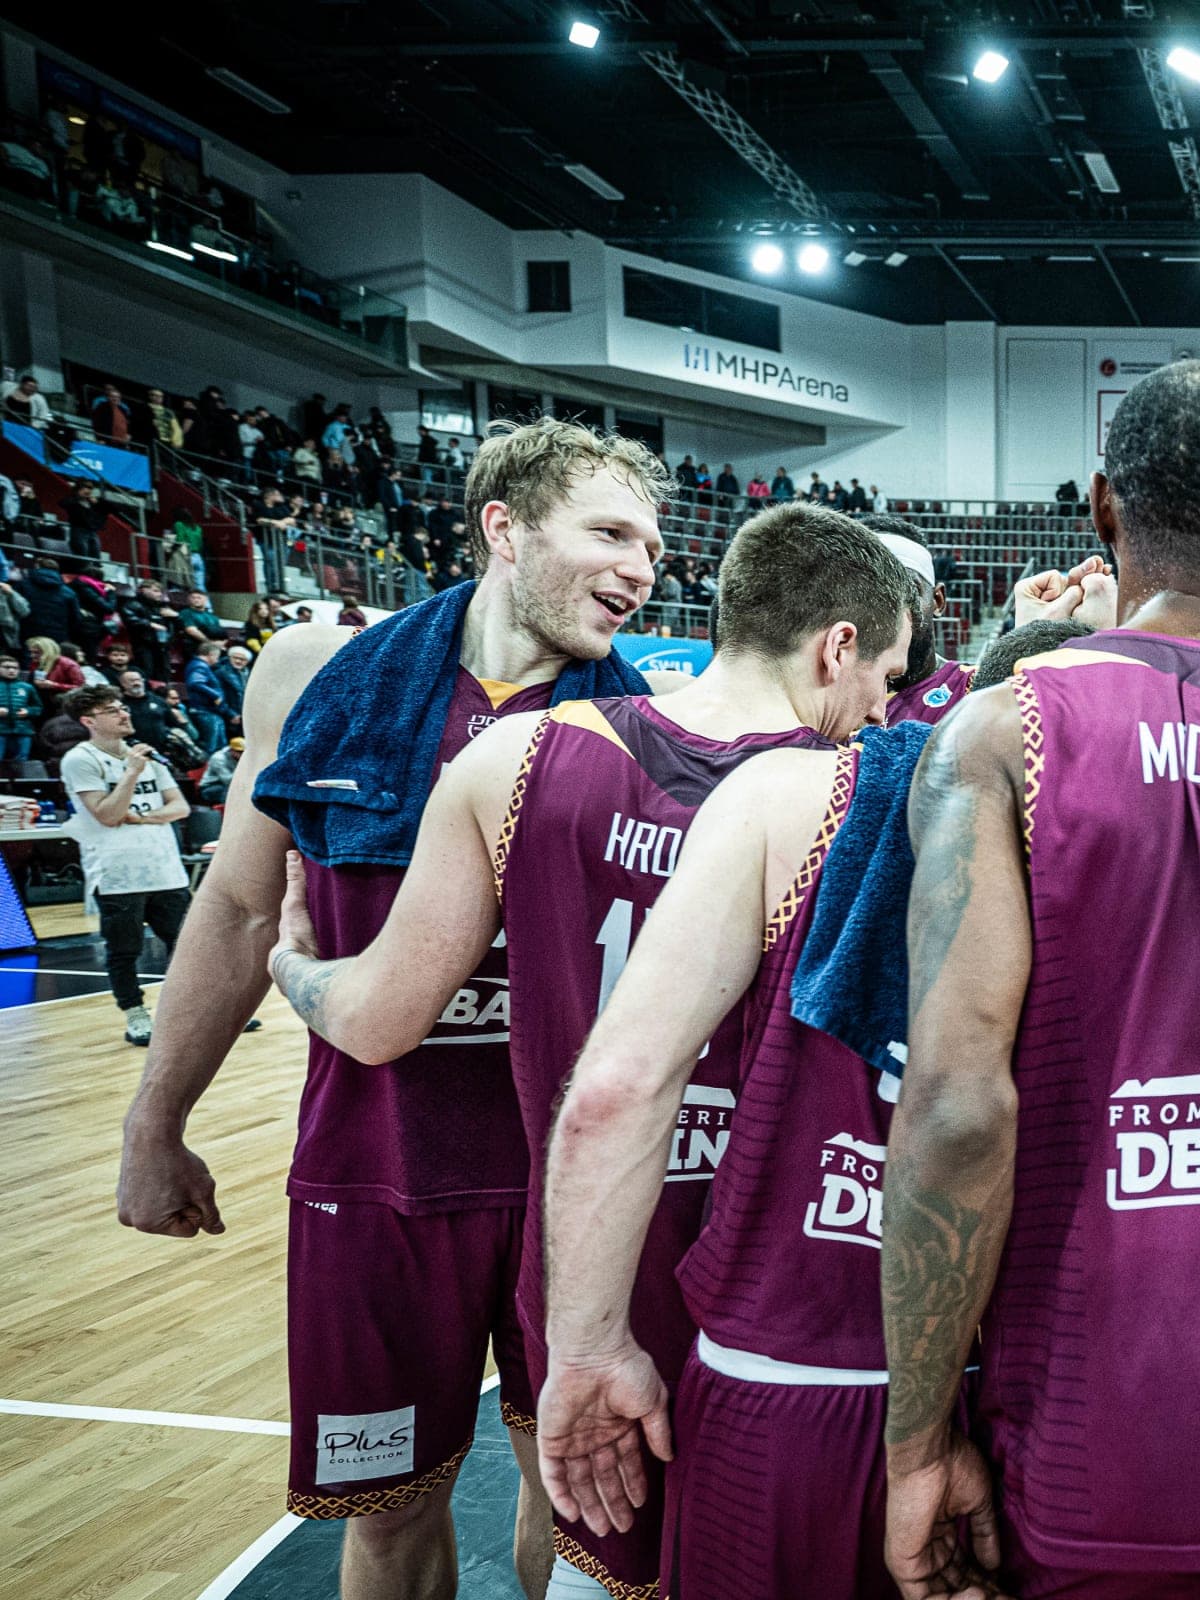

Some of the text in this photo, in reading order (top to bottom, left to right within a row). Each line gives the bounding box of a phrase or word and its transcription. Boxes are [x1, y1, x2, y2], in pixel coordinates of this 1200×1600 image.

[717, 351, 849, 402] MHPArena
[324, 1426, 410, 1457] Plus
[328, 1451, 404, 1464] COLLECTION
